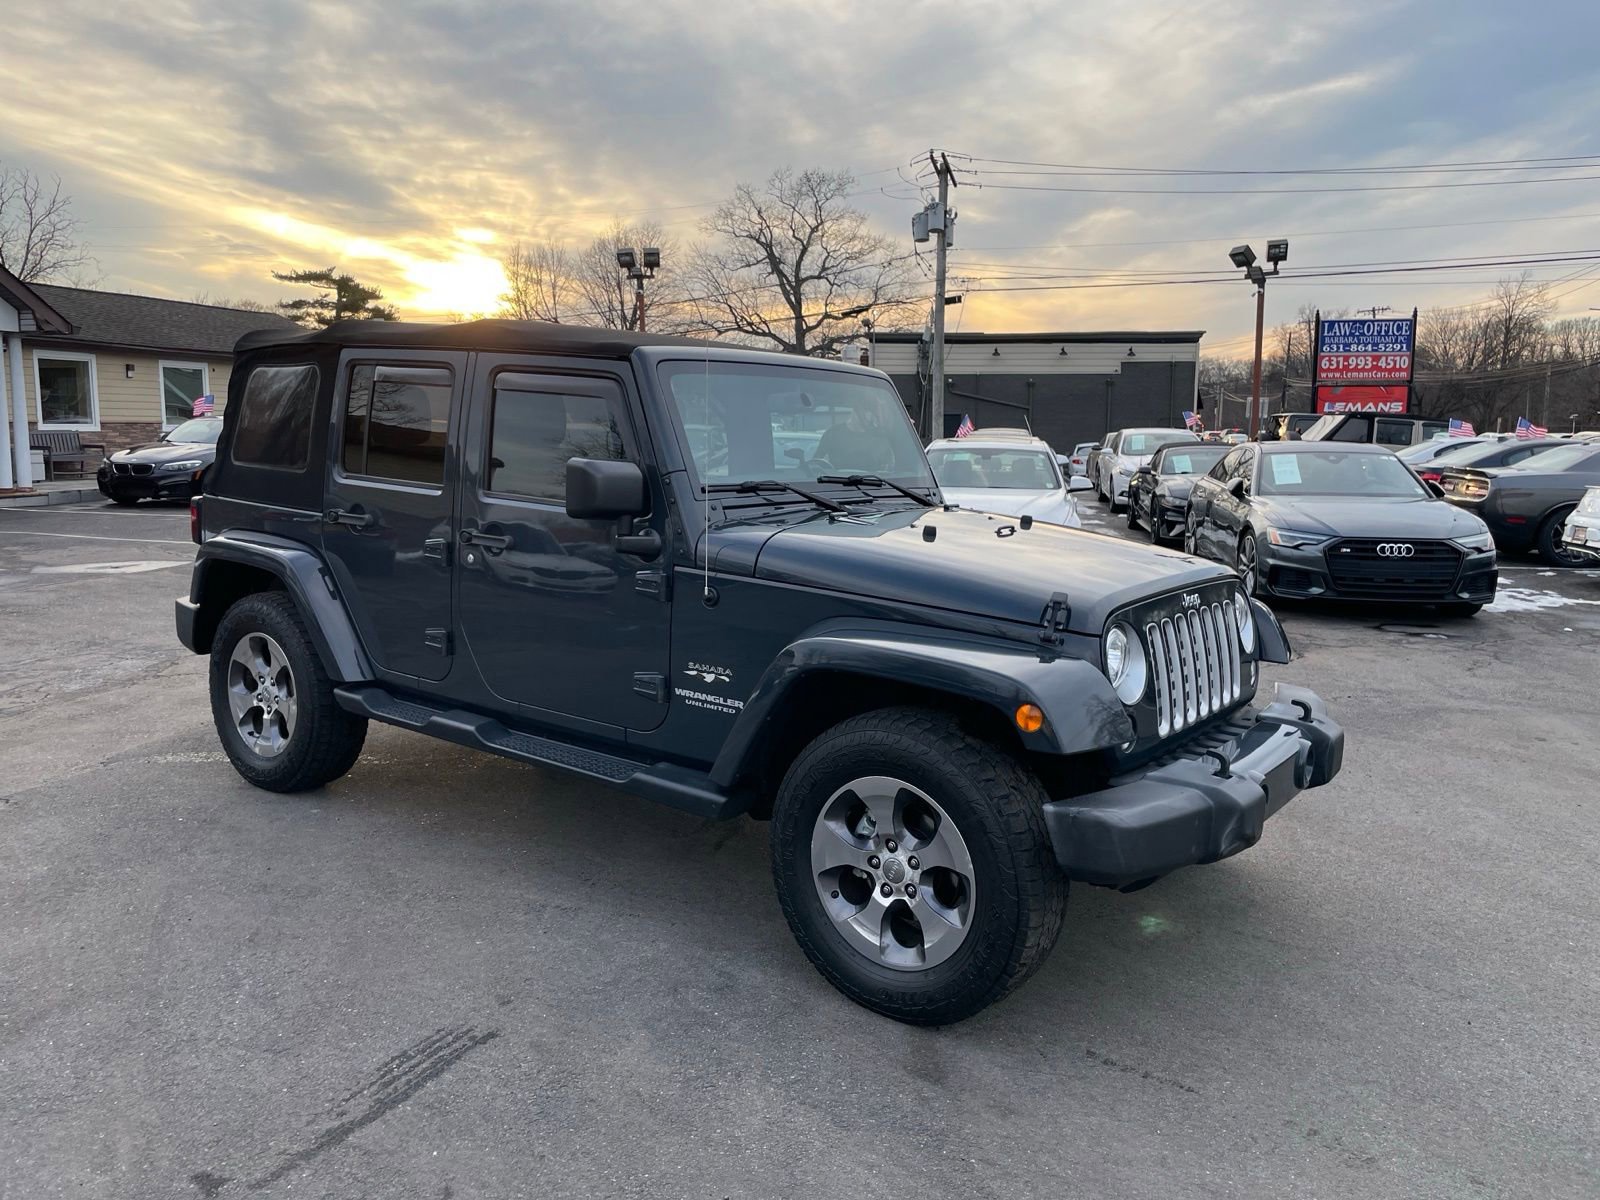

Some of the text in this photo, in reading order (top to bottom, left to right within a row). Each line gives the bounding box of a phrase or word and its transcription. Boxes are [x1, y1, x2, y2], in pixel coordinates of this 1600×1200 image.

[1323, 321, 1410, 336] LAW OFFICE
[1323, 344, 1407, 352] 631-864-5291
[1321, 356, 1409, 369] 631-993-4510
[1320, 370, 1407, 379] www.LemansCars.com
[1323, 402, 1403, 413] LEMANS
[1182, 593, 1201, 608] Jeep
[687, 662, 733, 676] SAHARA
[674, 687, 744, 709] WRANGLER
[685, 699, 736, 714] UNLIMITED
